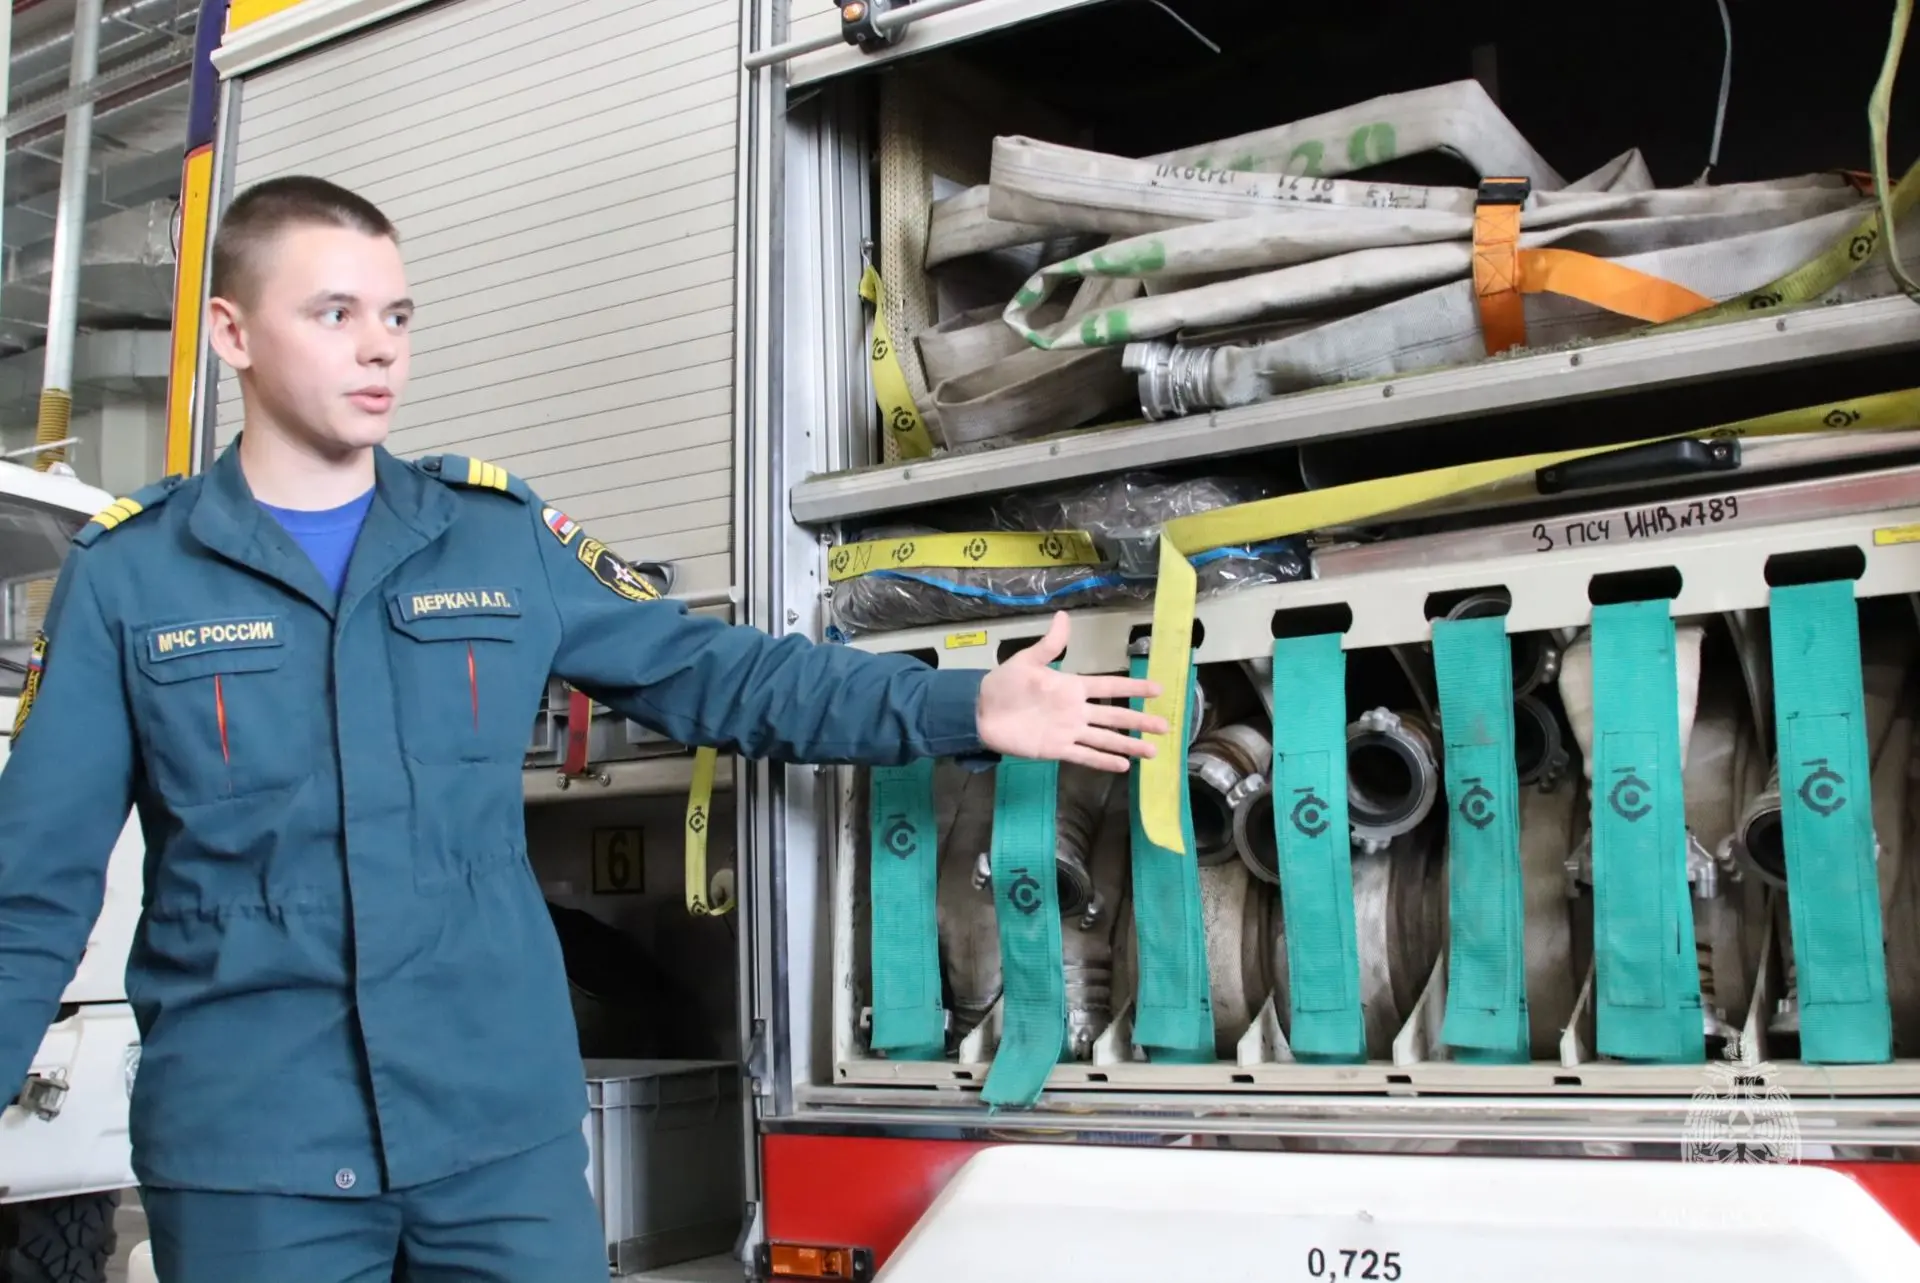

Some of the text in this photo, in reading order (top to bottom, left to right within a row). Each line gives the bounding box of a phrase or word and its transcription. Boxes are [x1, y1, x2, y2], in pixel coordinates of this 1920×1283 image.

[1565, 519, 1610, 546] ПСЧ
[412, 591, 512, 616] ДЕРКАЧ А.П.
[158, 621, 275, 653] МЧС РОССИИ
[607, 831, 631, 889] 6
[1307, 1247, 1402, 1283] 0,725
